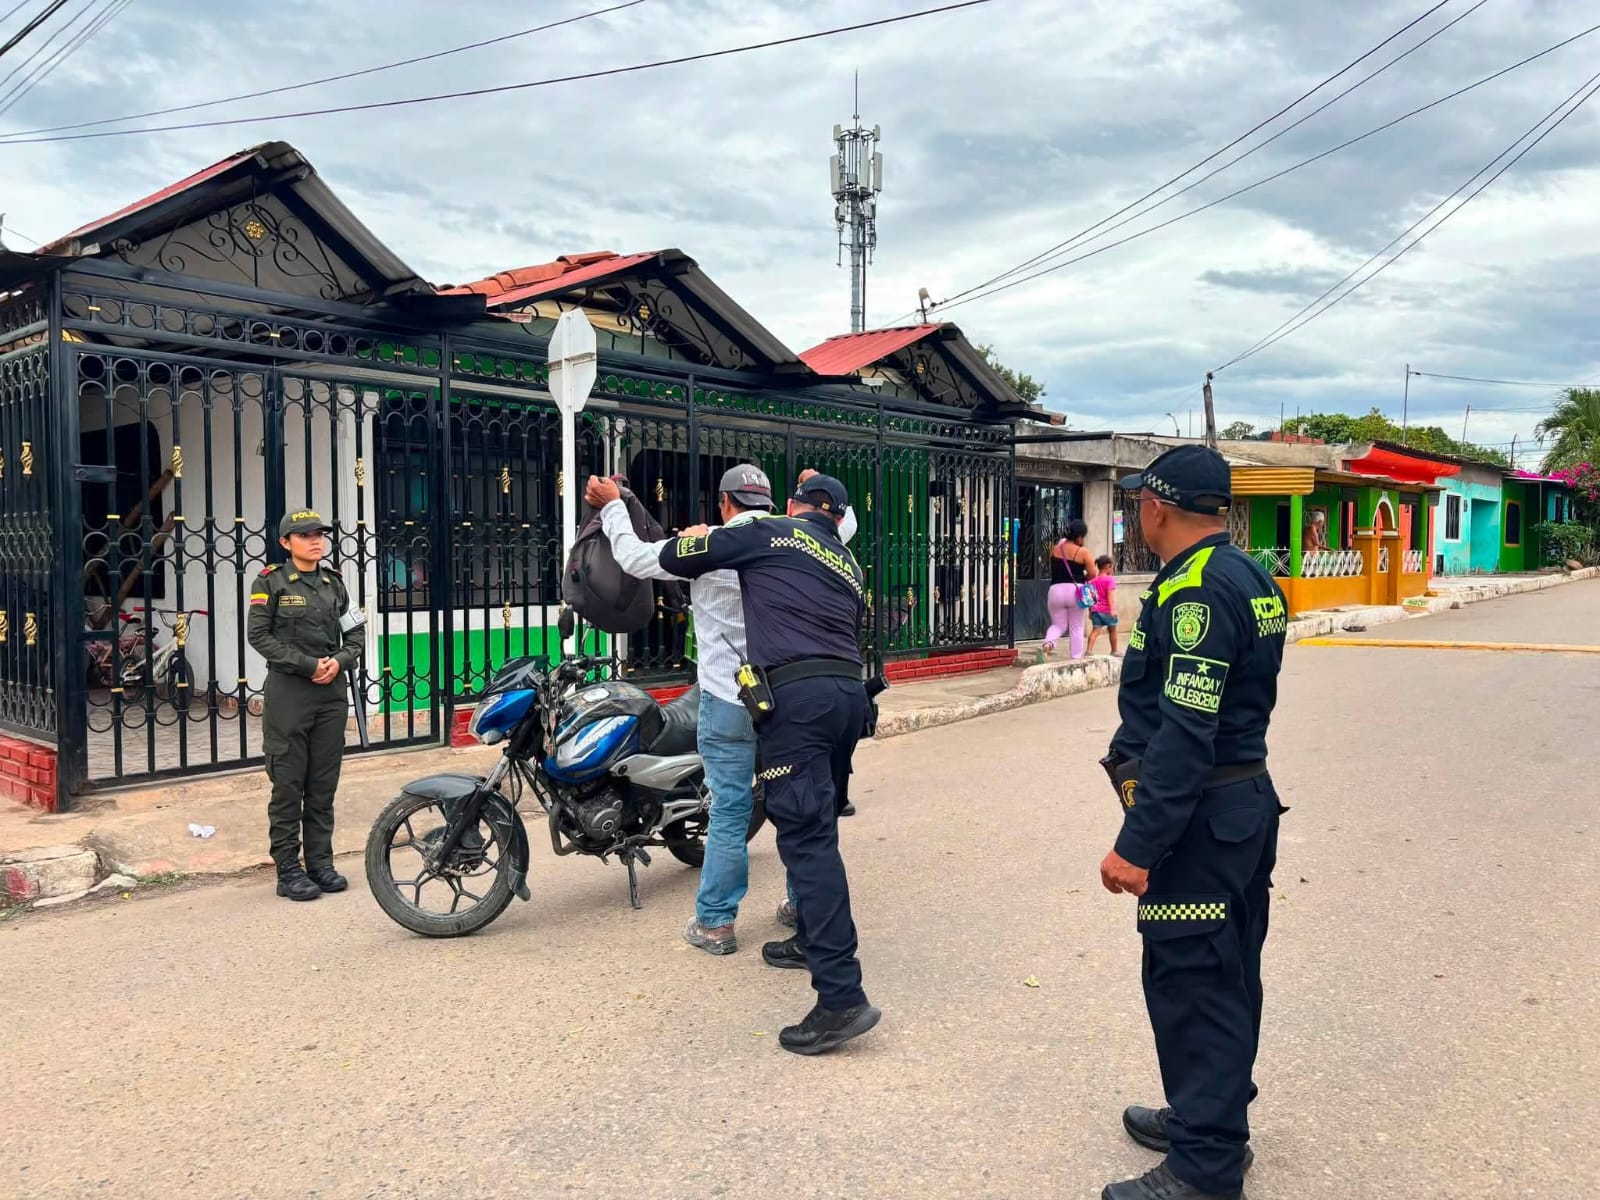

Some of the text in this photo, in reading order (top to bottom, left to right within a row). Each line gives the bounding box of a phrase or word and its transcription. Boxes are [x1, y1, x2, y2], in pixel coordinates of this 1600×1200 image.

[793, 527, 855, 578] POLICÍA
[1176, 671, 1222, 693] INFANCIA Y
